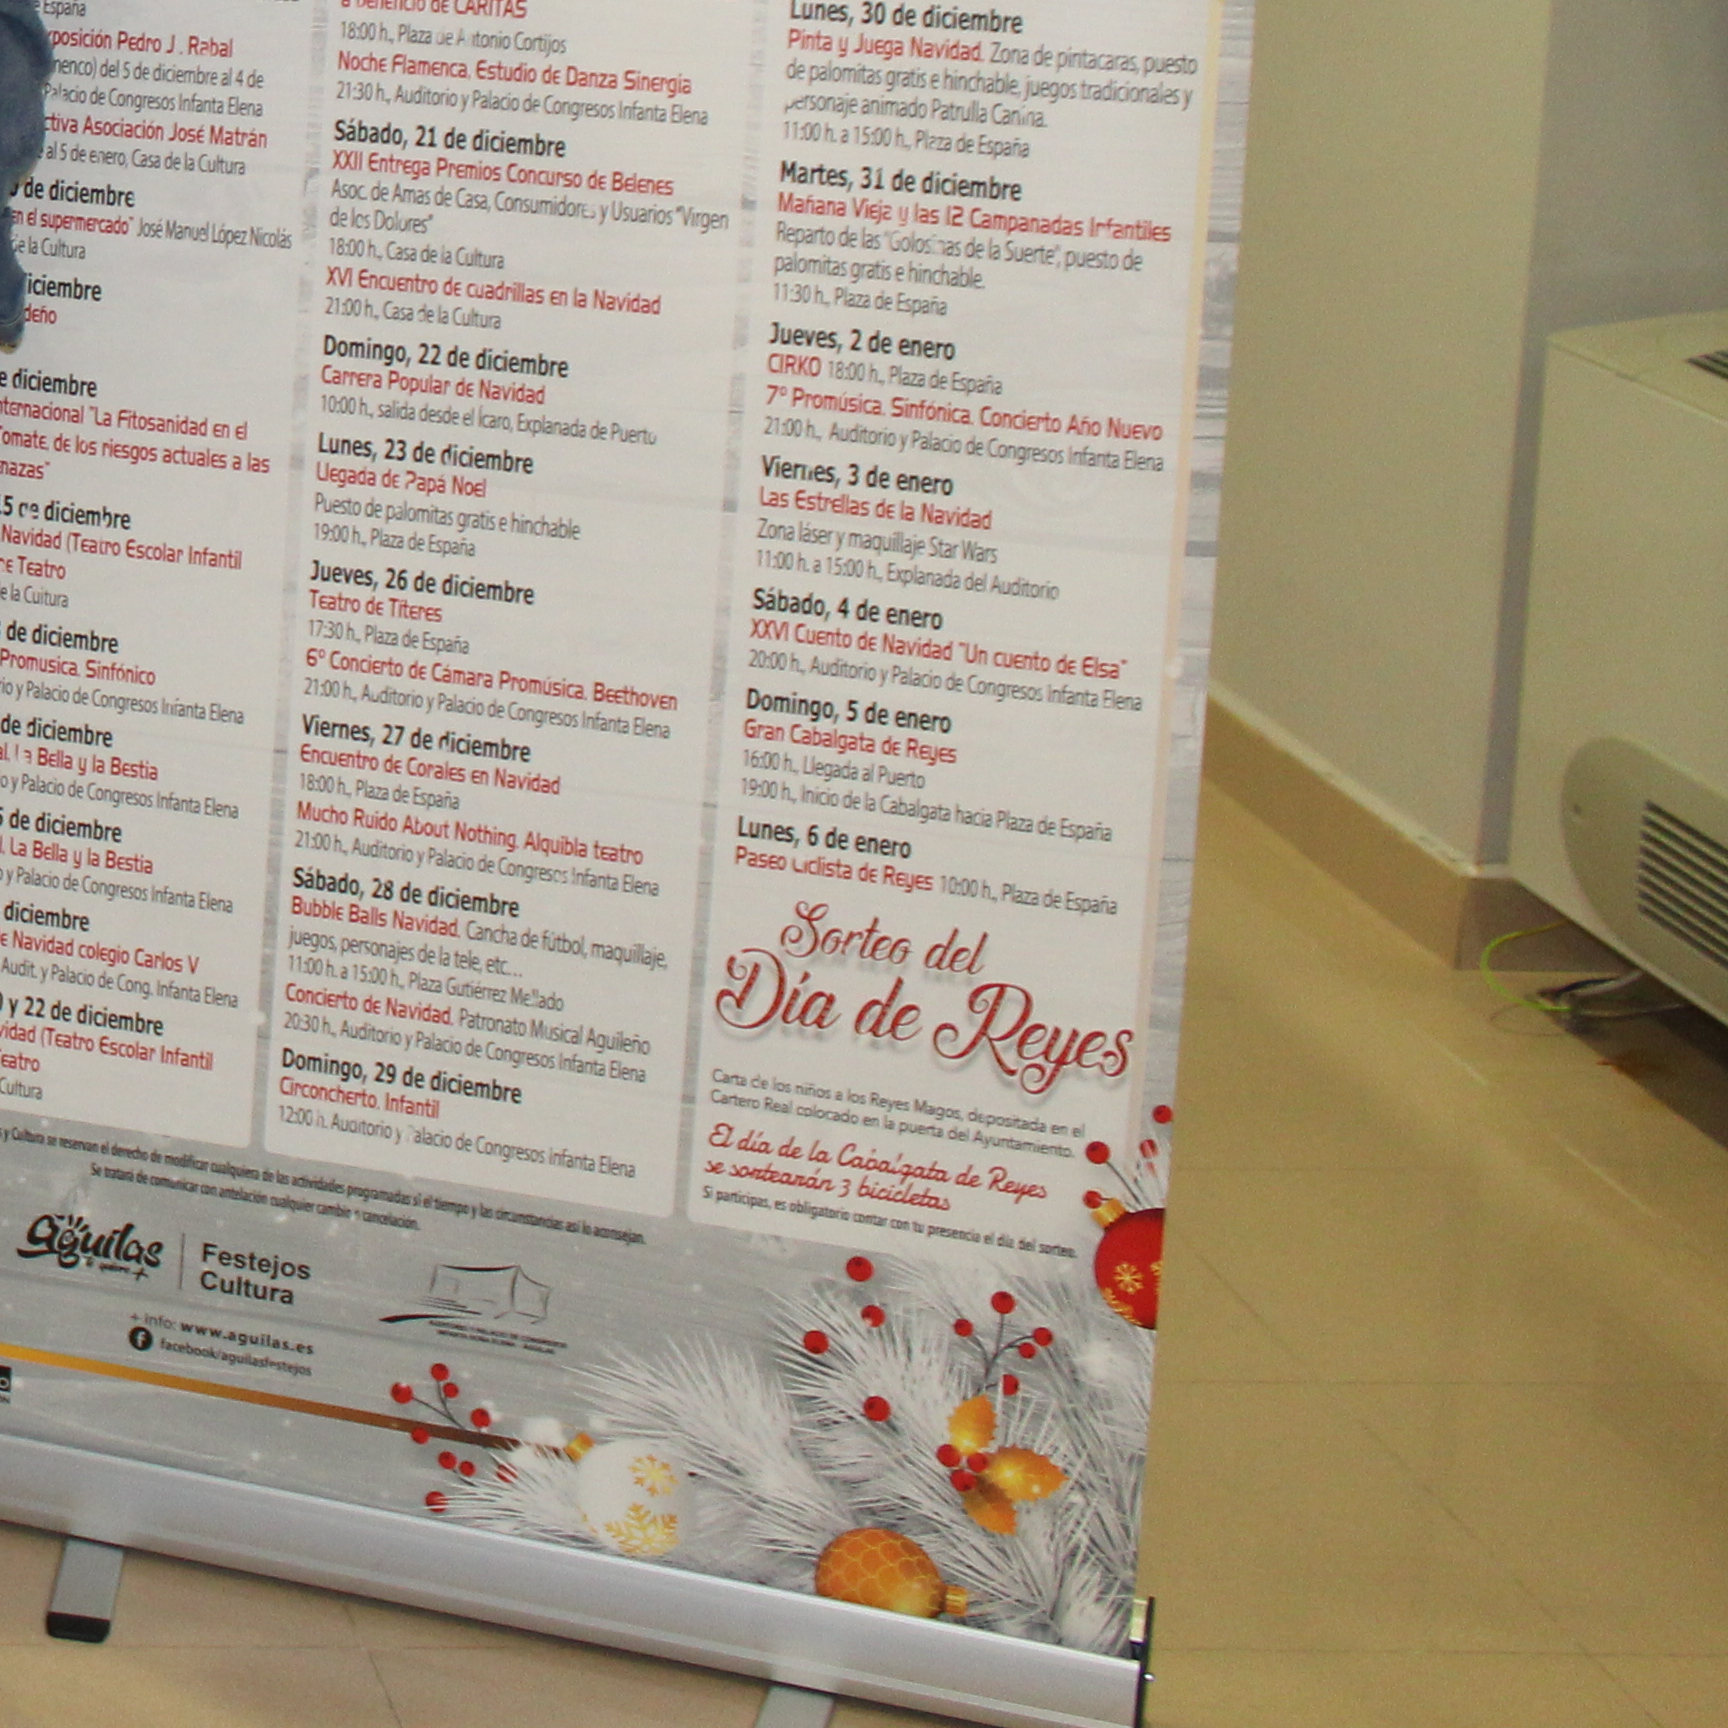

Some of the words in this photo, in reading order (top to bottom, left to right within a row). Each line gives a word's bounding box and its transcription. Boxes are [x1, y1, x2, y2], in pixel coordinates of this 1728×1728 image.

[860, 1, 886, 25] 30
[891, 4, 916, 27] de
[921, 6, 1022, 34] diciembre
[322, 334, 411, 366] Domingo,
[417, 342, 441, 365] 22
[446, 344, 470, 368] de
[474, 347, 568, 378] diciembre
[768, 322, 842, 352] Jueves,
[849, 328, 861, 351] 2
[867, 330, 892, 354] de
[897, 337, 955, 360] enero
[320, 363, 382, 389] Carrera
[387, 369, 451, 395] Popular
[454, 377, 474, 398] de
[478, 378, 545, 404] Navidad
[767, 353, 822, 377] CIRKO
[752, 589, 830, 619] Sábado,
[836, 597, 849, 618] 4
[855, 600, 880, 622] de
[885, 607, 942, 630] enero
[5, 619, 27, 643] de
[31, 623, 118, 653] diciembre
[737, 817, 800, 847] Lunes,
[806, 825, 818, 846] 6
[824, 828, 848, 850] de
[853, 835, 911, 859] enero
[780, 900, 912, 965] Sorteo
[924, 928, 987, 975] del
[716, 947, 841, 1031] Día
[855, 975, 926, 1041] de
[932, 981, 1136, 1096] Reyes
[202, 1243, 311, 1279] Festejos
[200, 1270, 294, 1305] Cultura
[181, 1322, 314, 1354] www.aguilas.es
